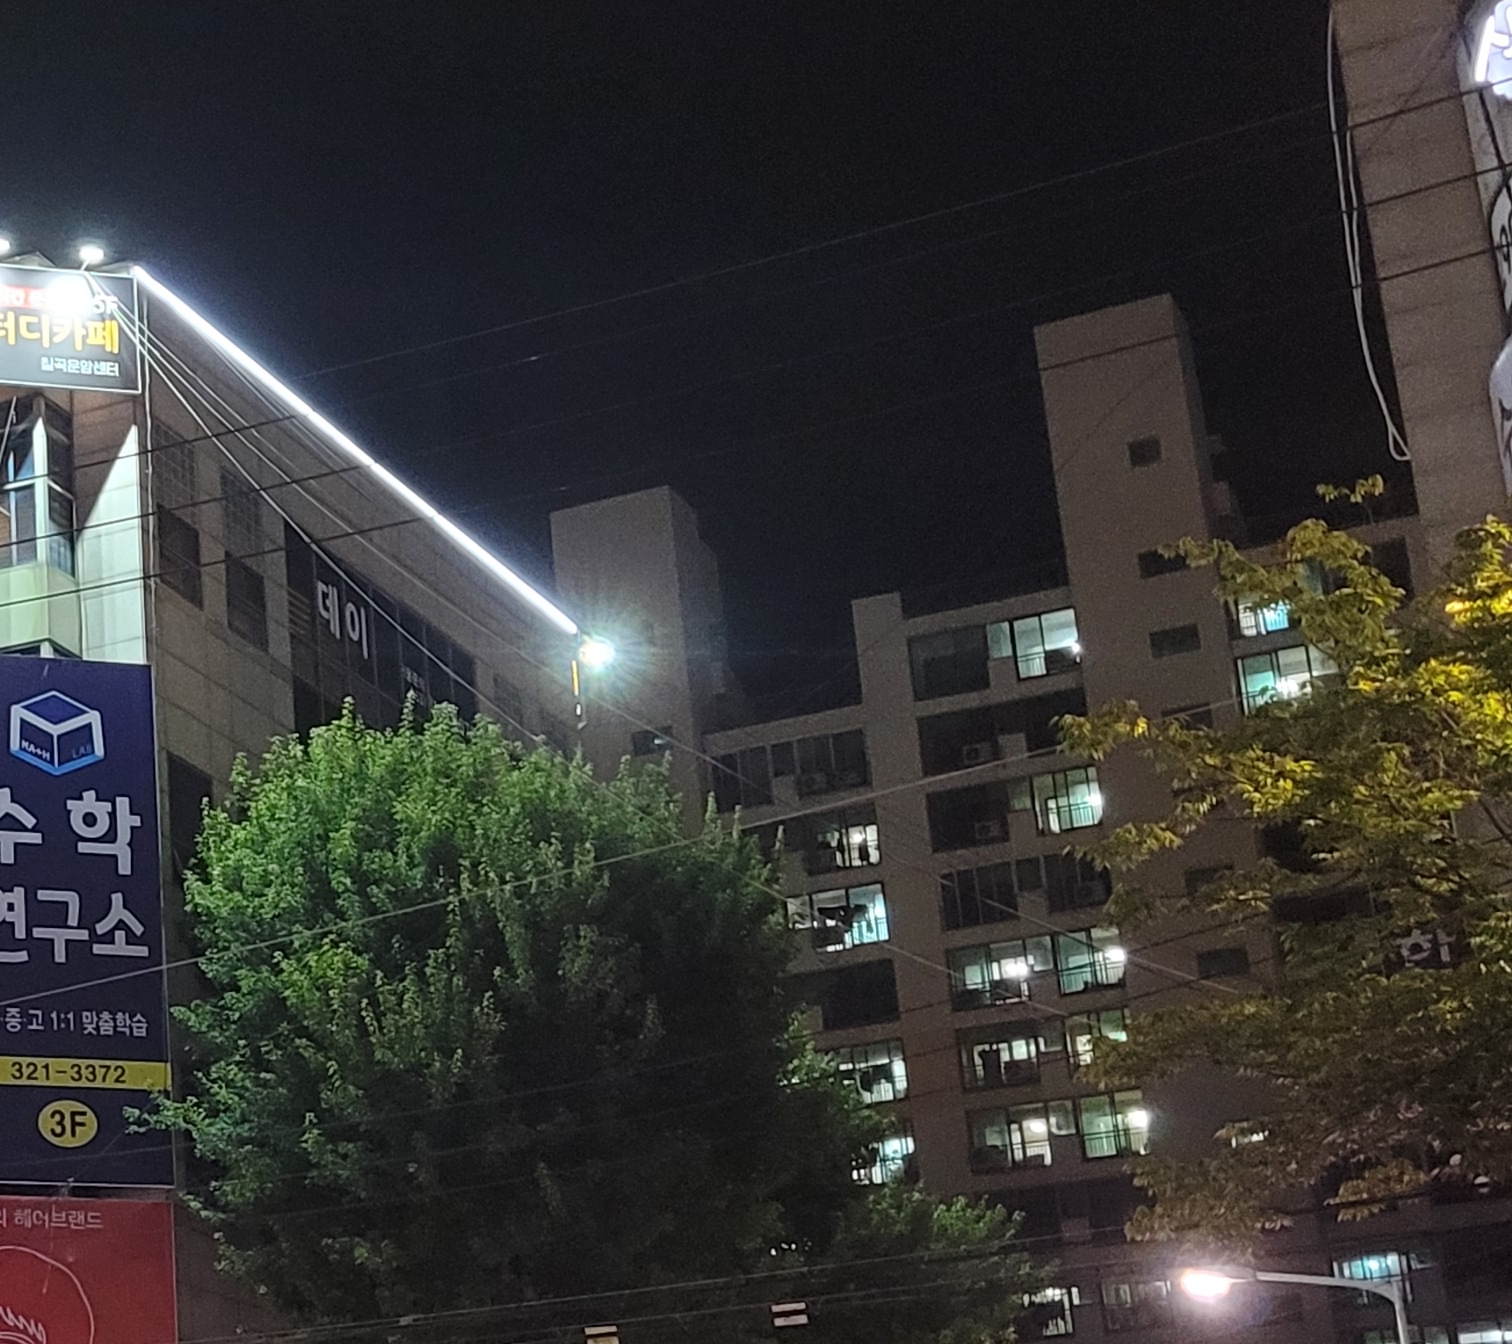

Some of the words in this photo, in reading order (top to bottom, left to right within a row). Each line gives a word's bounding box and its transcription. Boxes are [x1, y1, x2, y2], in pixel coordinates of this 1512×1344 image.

[317, 580, 369, 660] 데이
[49, 1010, 78, 1033] 1:1
[81, 1010, 149, 1038] 맞춤학습
[10, 1062, 128, 1086] 321-3372
[49, 1108, 89, 1138] 3F
[14, 1208, 104, 1231] 헤어브랜드
